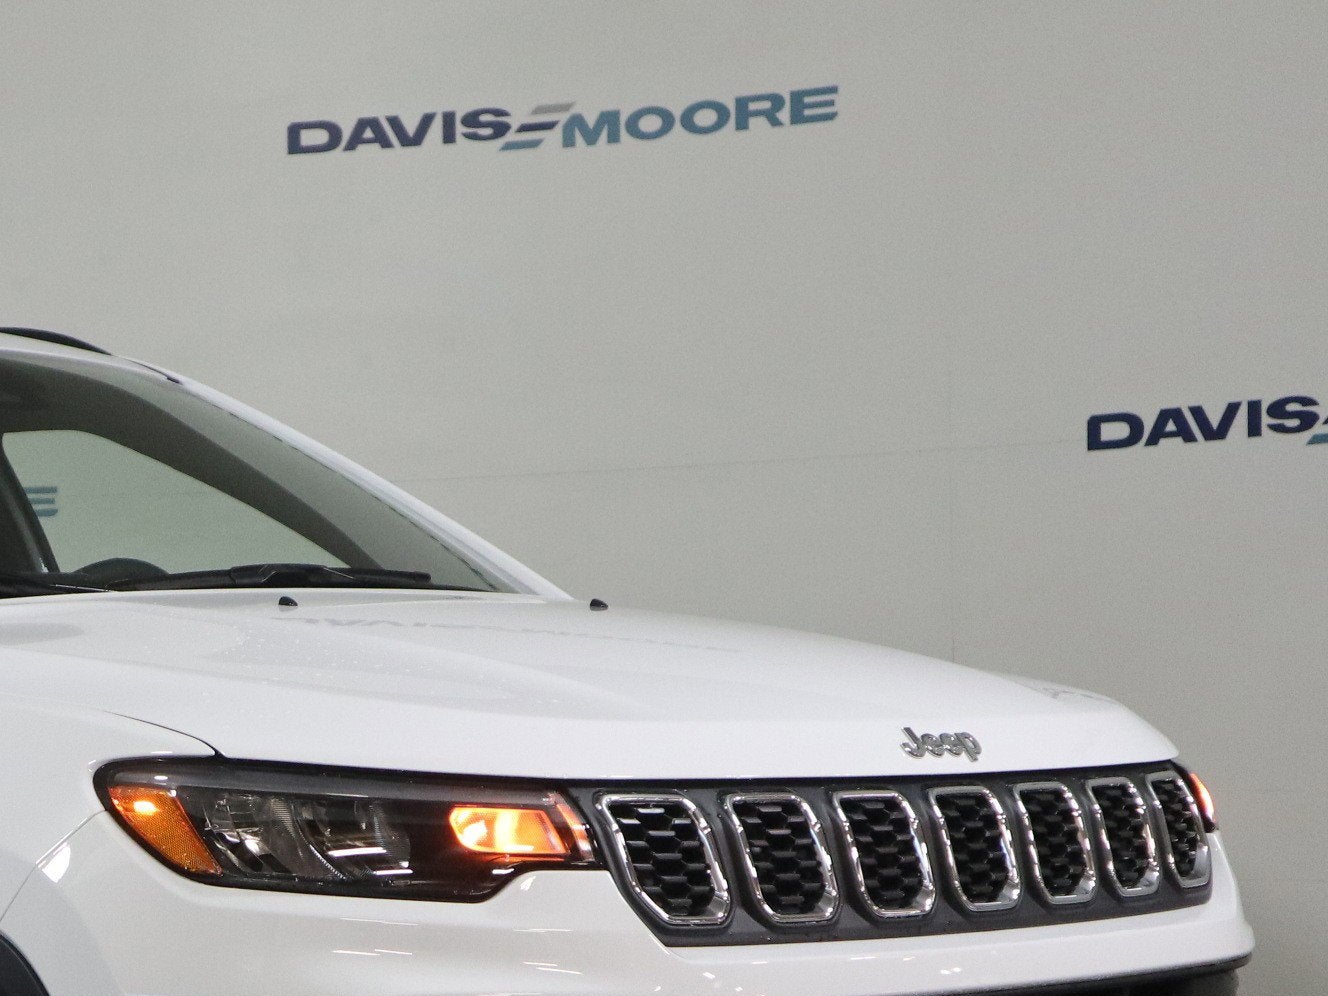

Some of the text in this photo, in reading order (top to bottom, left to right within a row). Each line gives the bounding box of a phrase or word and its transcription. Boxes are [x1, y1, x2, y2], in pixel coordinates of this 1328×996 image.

[286, 85, 839, 155] DAVIS MOORE
[1087, 395, 1321, 451] DAVIS
[900, 727, 982, 762] Jeep
